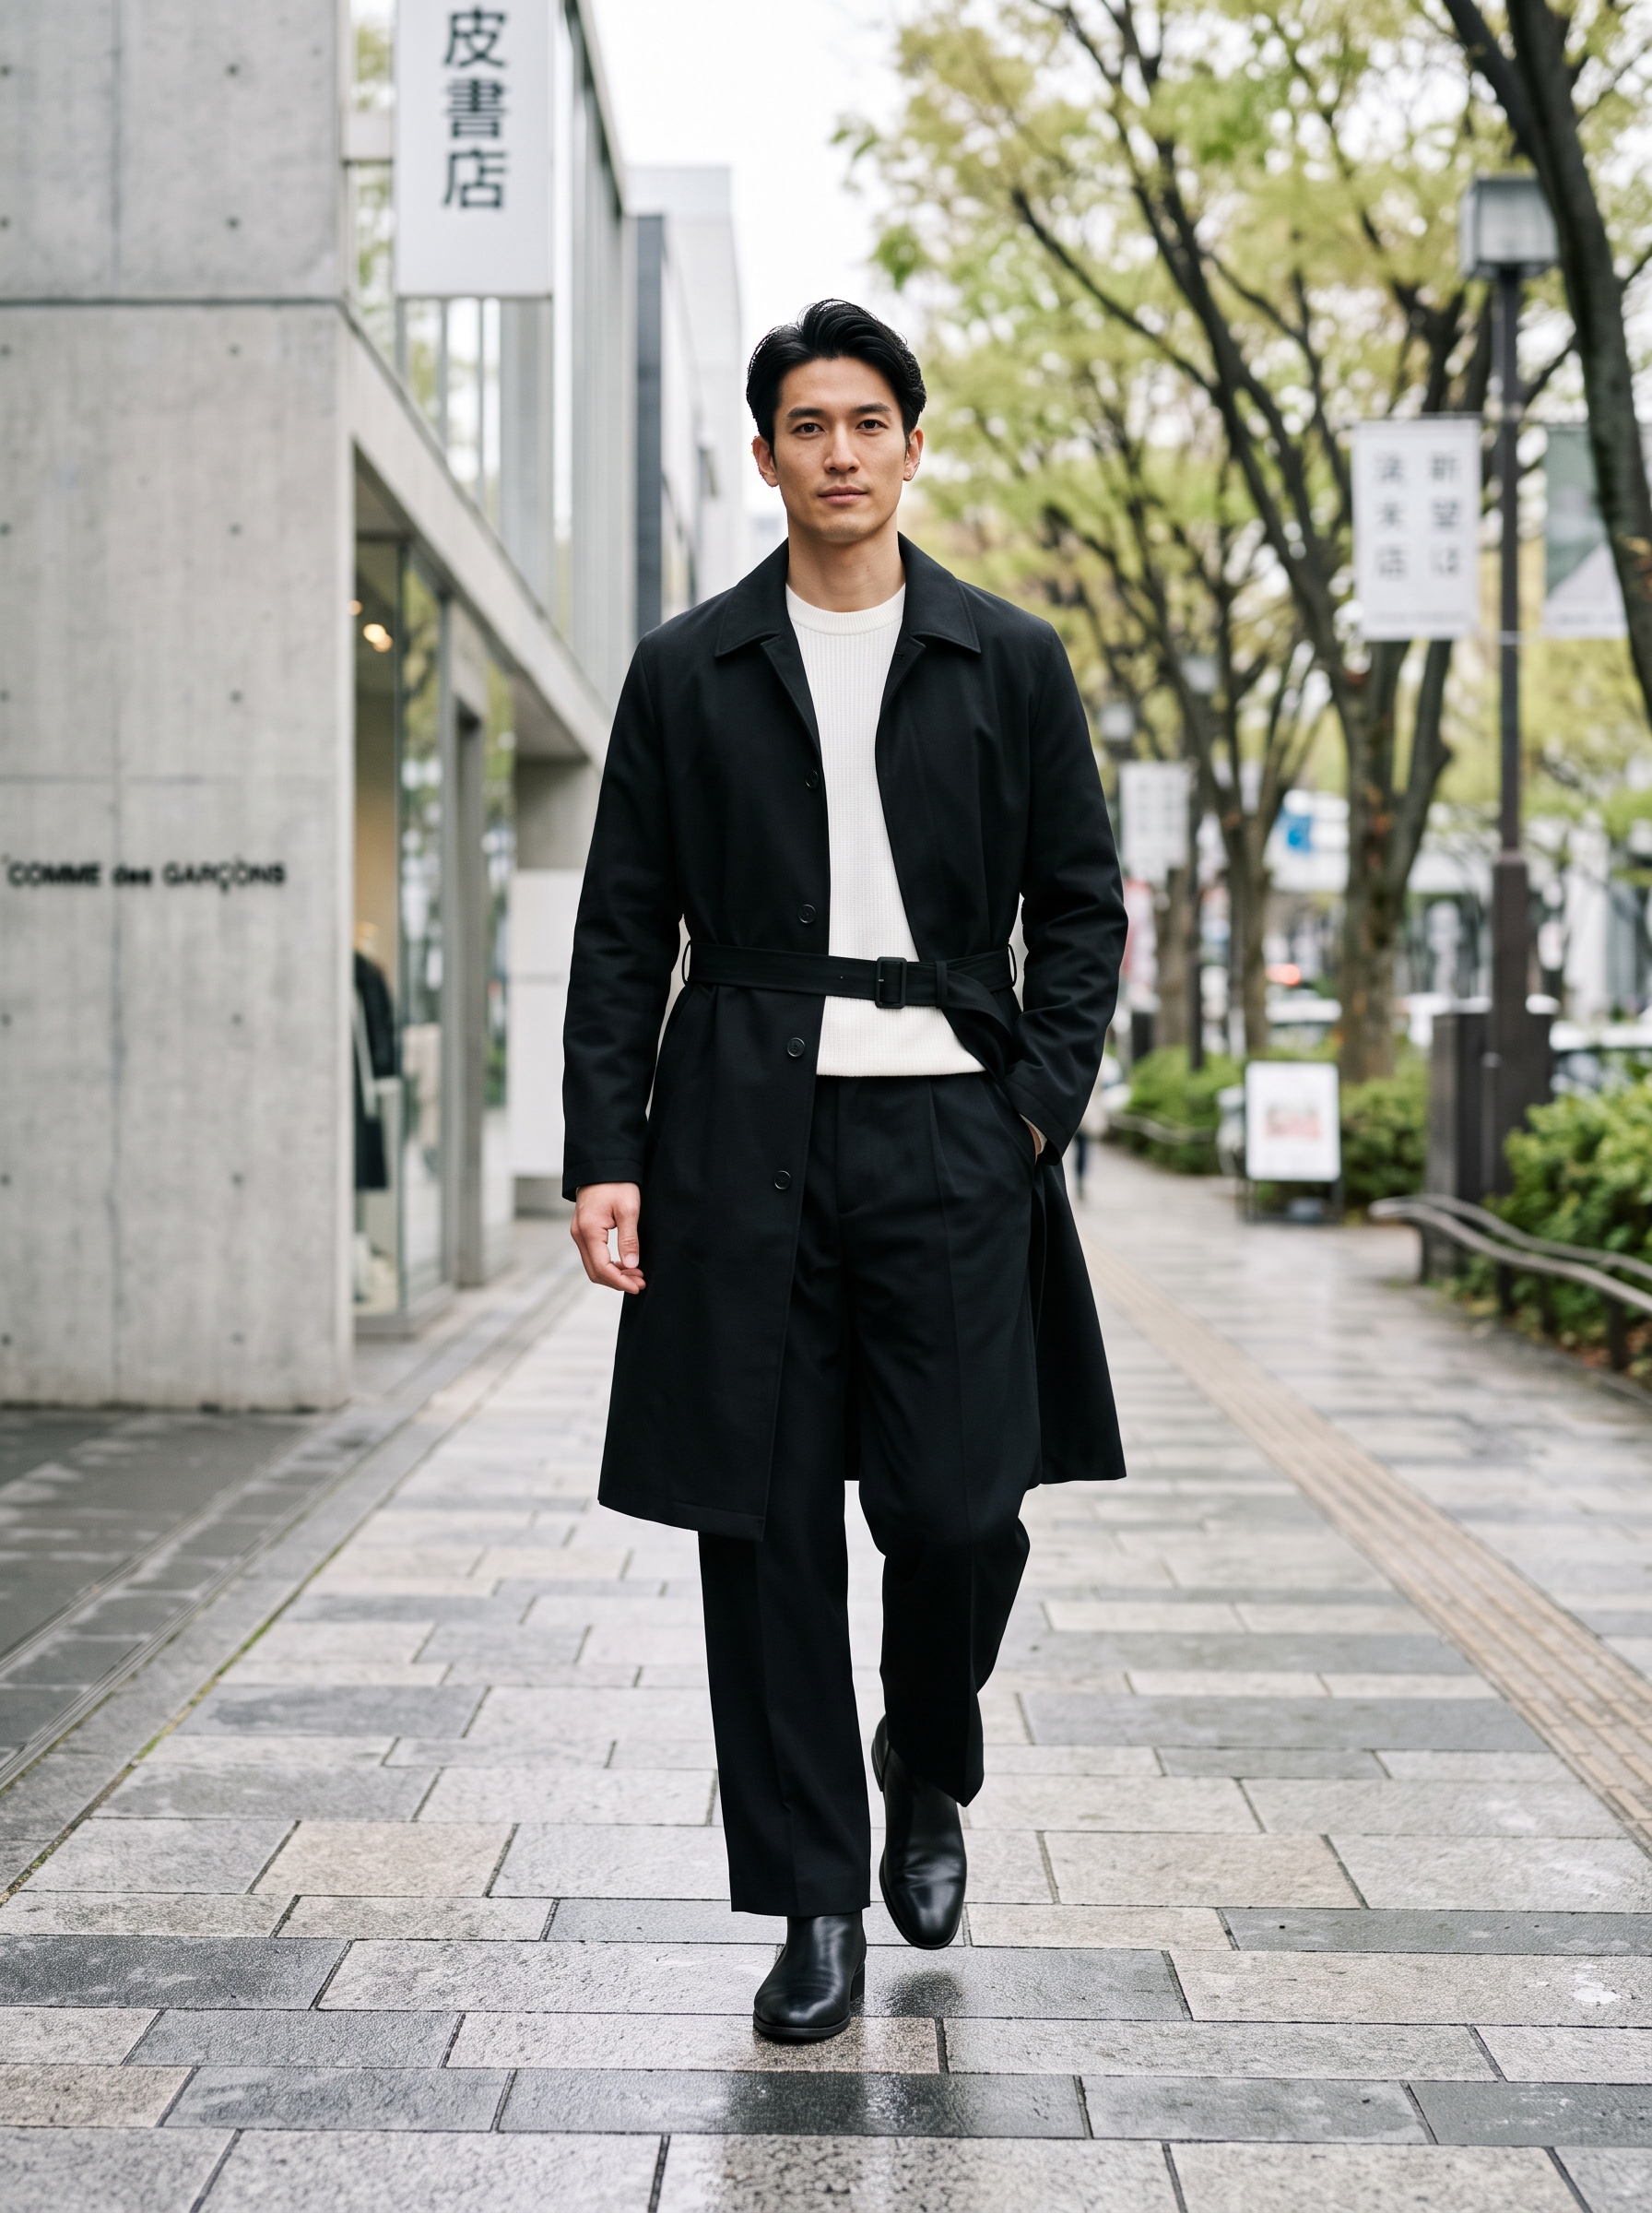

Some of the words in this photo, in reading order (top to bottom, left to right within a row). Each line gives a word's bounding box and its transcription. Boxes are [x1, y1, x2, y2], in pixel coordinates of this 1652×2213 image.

[442, 6, 507, 210] 皮書店
[7, 861, 100, 887] COMME
